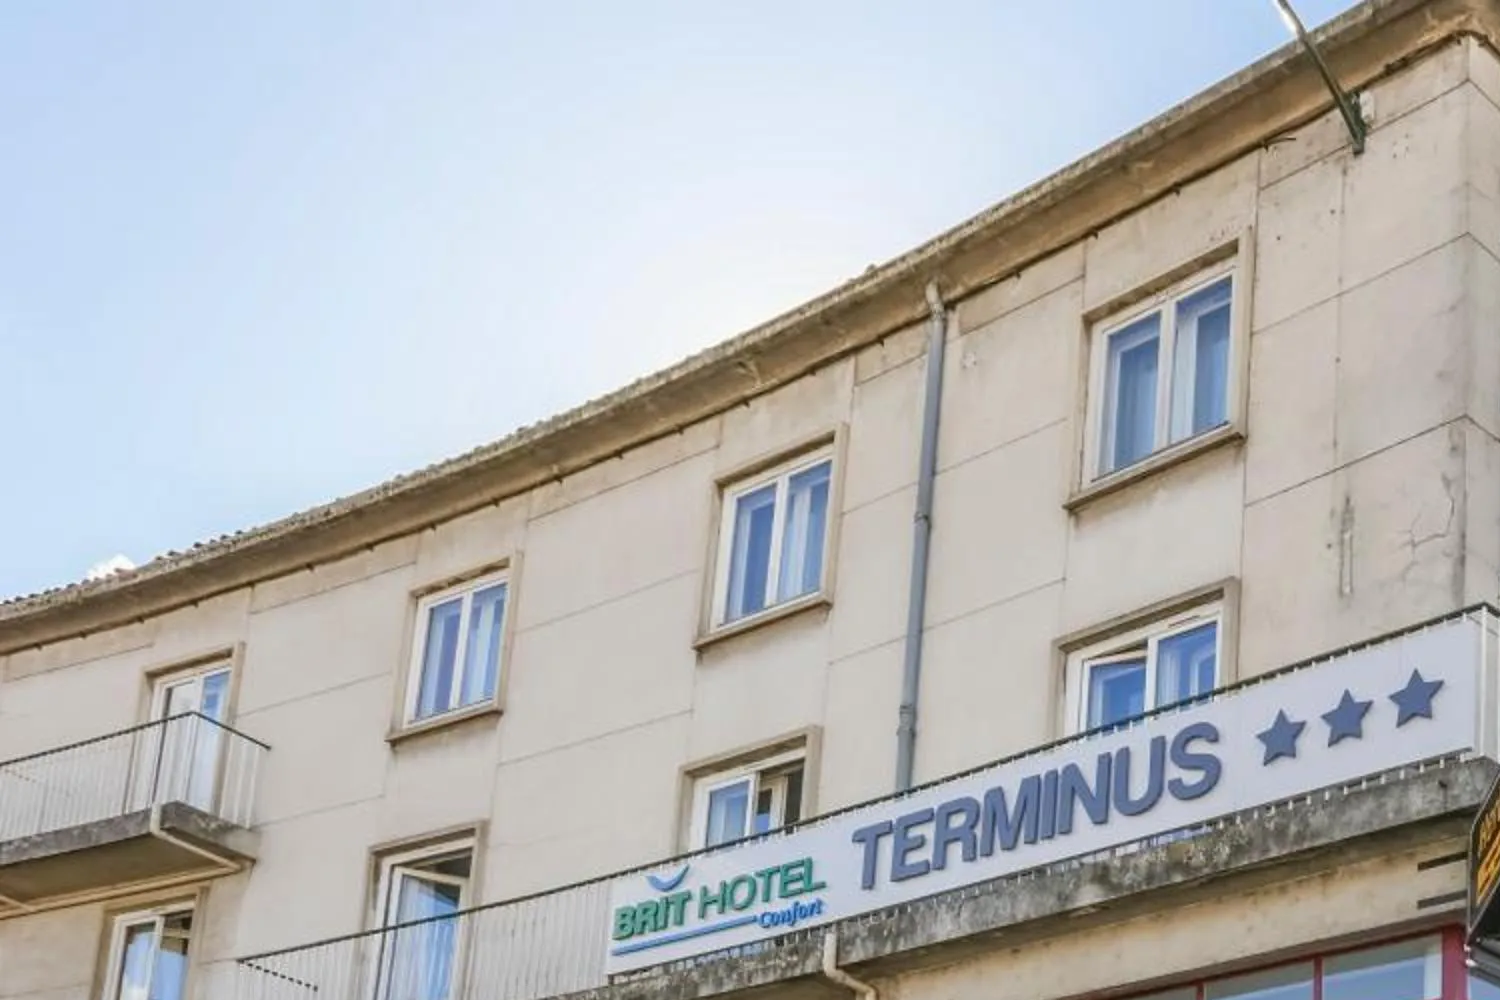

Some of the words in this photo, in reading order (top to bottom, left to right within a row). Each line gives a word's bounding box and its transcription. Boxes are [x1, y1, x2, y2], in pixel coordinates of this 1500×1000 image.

[852, 721, 1223, 890] TERMINUS
[612, 890, 692, 941] BRIT
[698, 856, 827, 919] HOTEL
[758, 897, 824, 928] Confort
